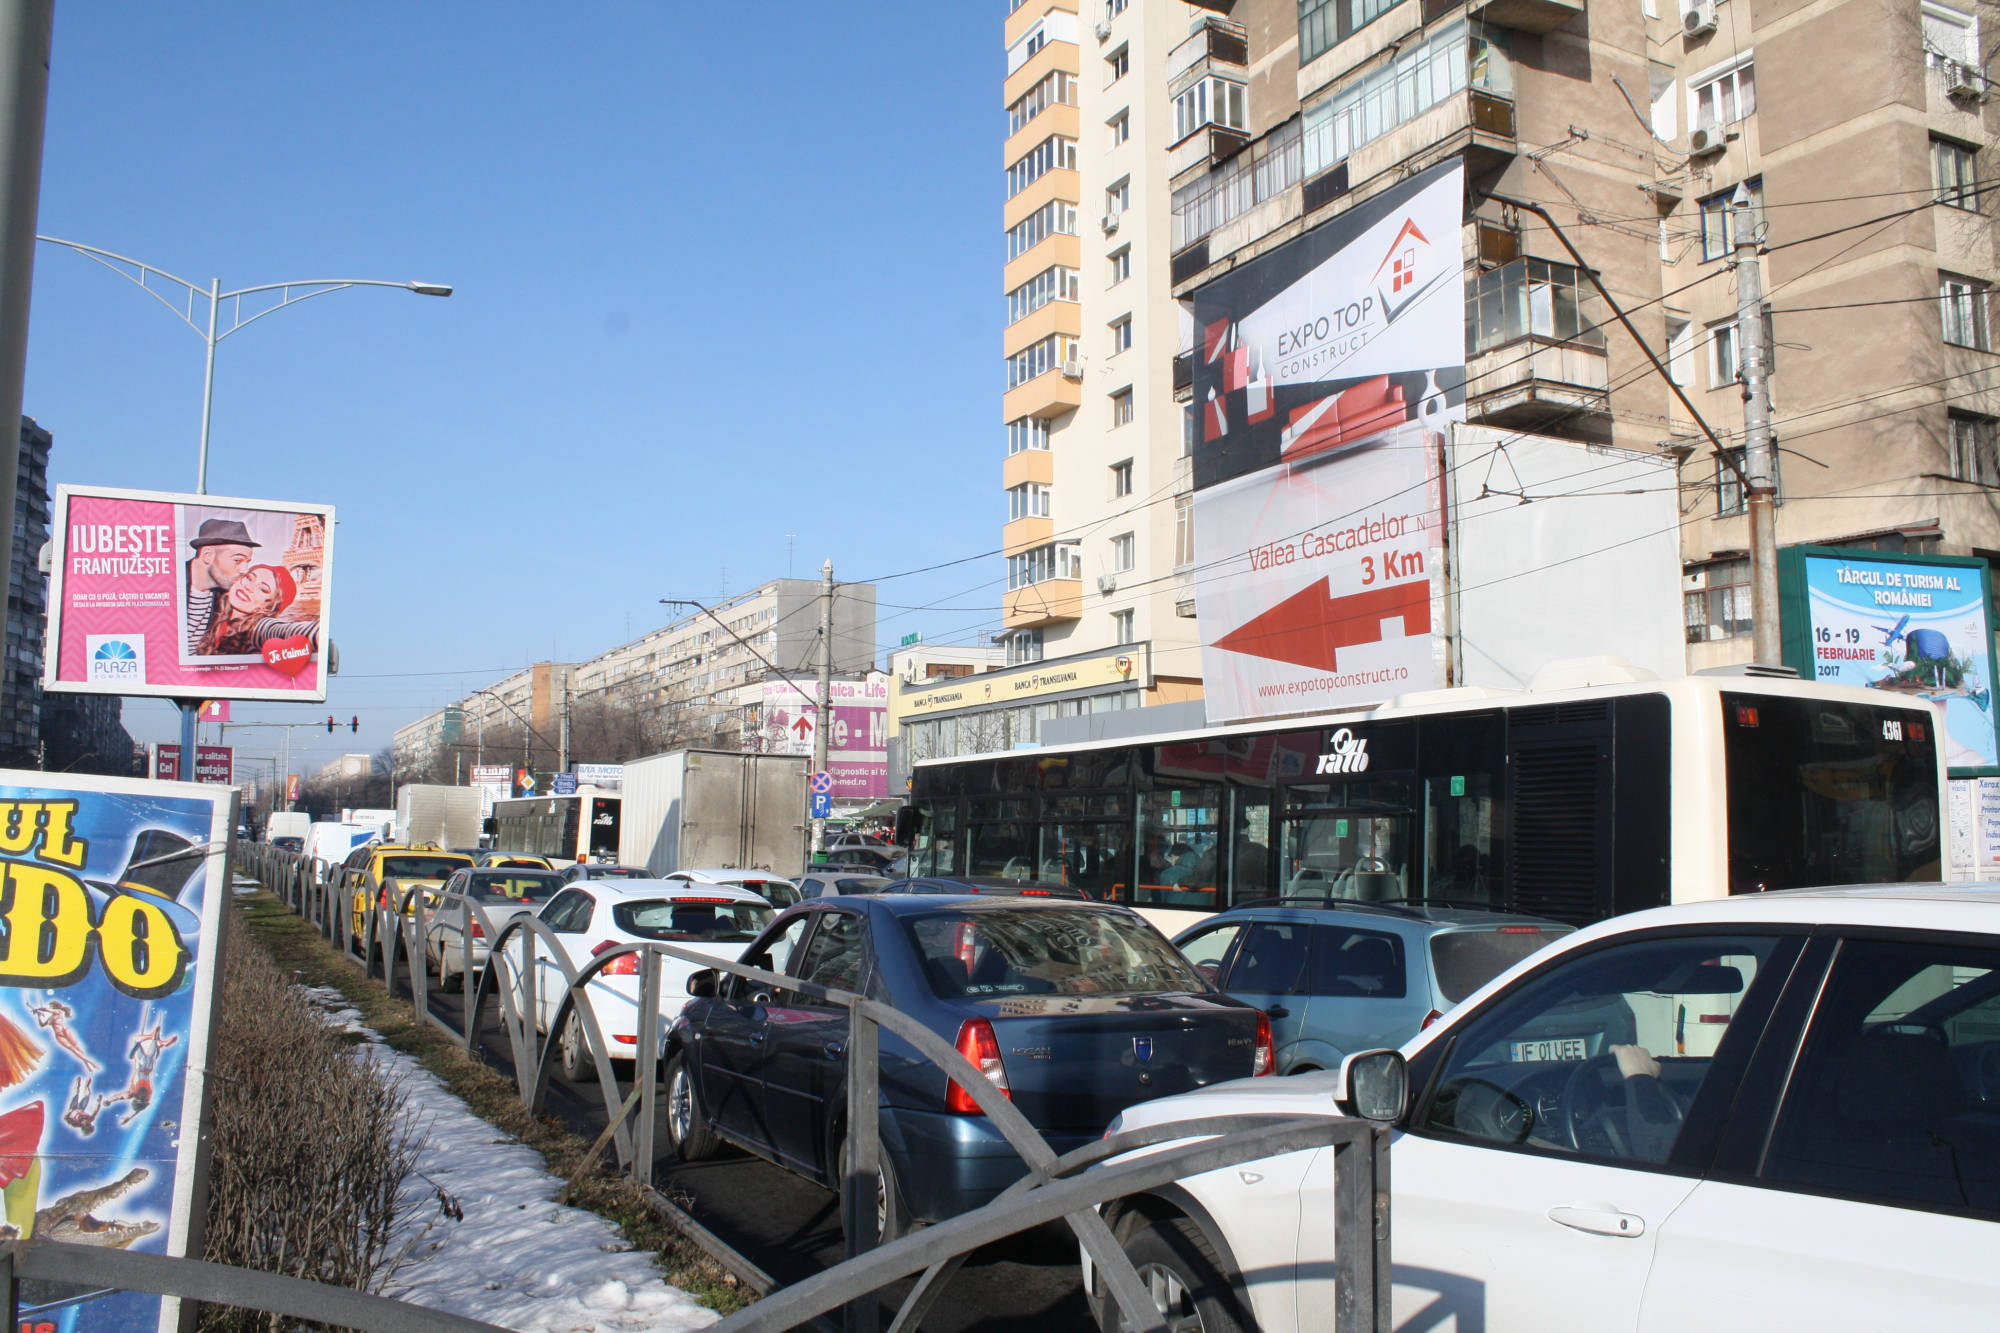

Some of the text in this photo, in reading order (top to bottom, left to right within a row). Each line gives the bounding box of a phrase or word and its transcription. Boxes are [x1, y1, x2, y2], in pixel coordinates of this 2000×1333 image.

[1278, 296, 1373, 357] EXPO TOP
[1280, 332, 1368, 378] CONSTRUCT
[1249, 542, 1295, 571] Valea
[1301, 512, 1409, 559] Cascadelor
[1360, 550, 1424, 585] 3 Km
[1836, 566, 1961, 591] TÂRGUL DE TURISM AL
[1874, 588, 1932, 607] ROMÂNIEI
[1815, 627, 1831, 643] 16
[1845, 628, 1860, 644] 19
[1816, 647, 1876, 661] FEBRUARIE
[94, 661, 137, 673] PLAZA
[1817, 665, 1840, 677] 2017
[865, 682, 887, 698] Life
[1014, 671, 1077, 691] BANCA TRANSILVANIA
[1258, 666, 1408, 697] www.expotopconstruct.ro
[1882, 719, 1903, 741] 4361
[159, 762, 173, 773] Cel
[196, 765, 229, 777] vantajos
[831, 778, 867, 786] e-med.ro
[816, 795, 826, 810] P
[1540, 1041, 1551, 1061] 01
